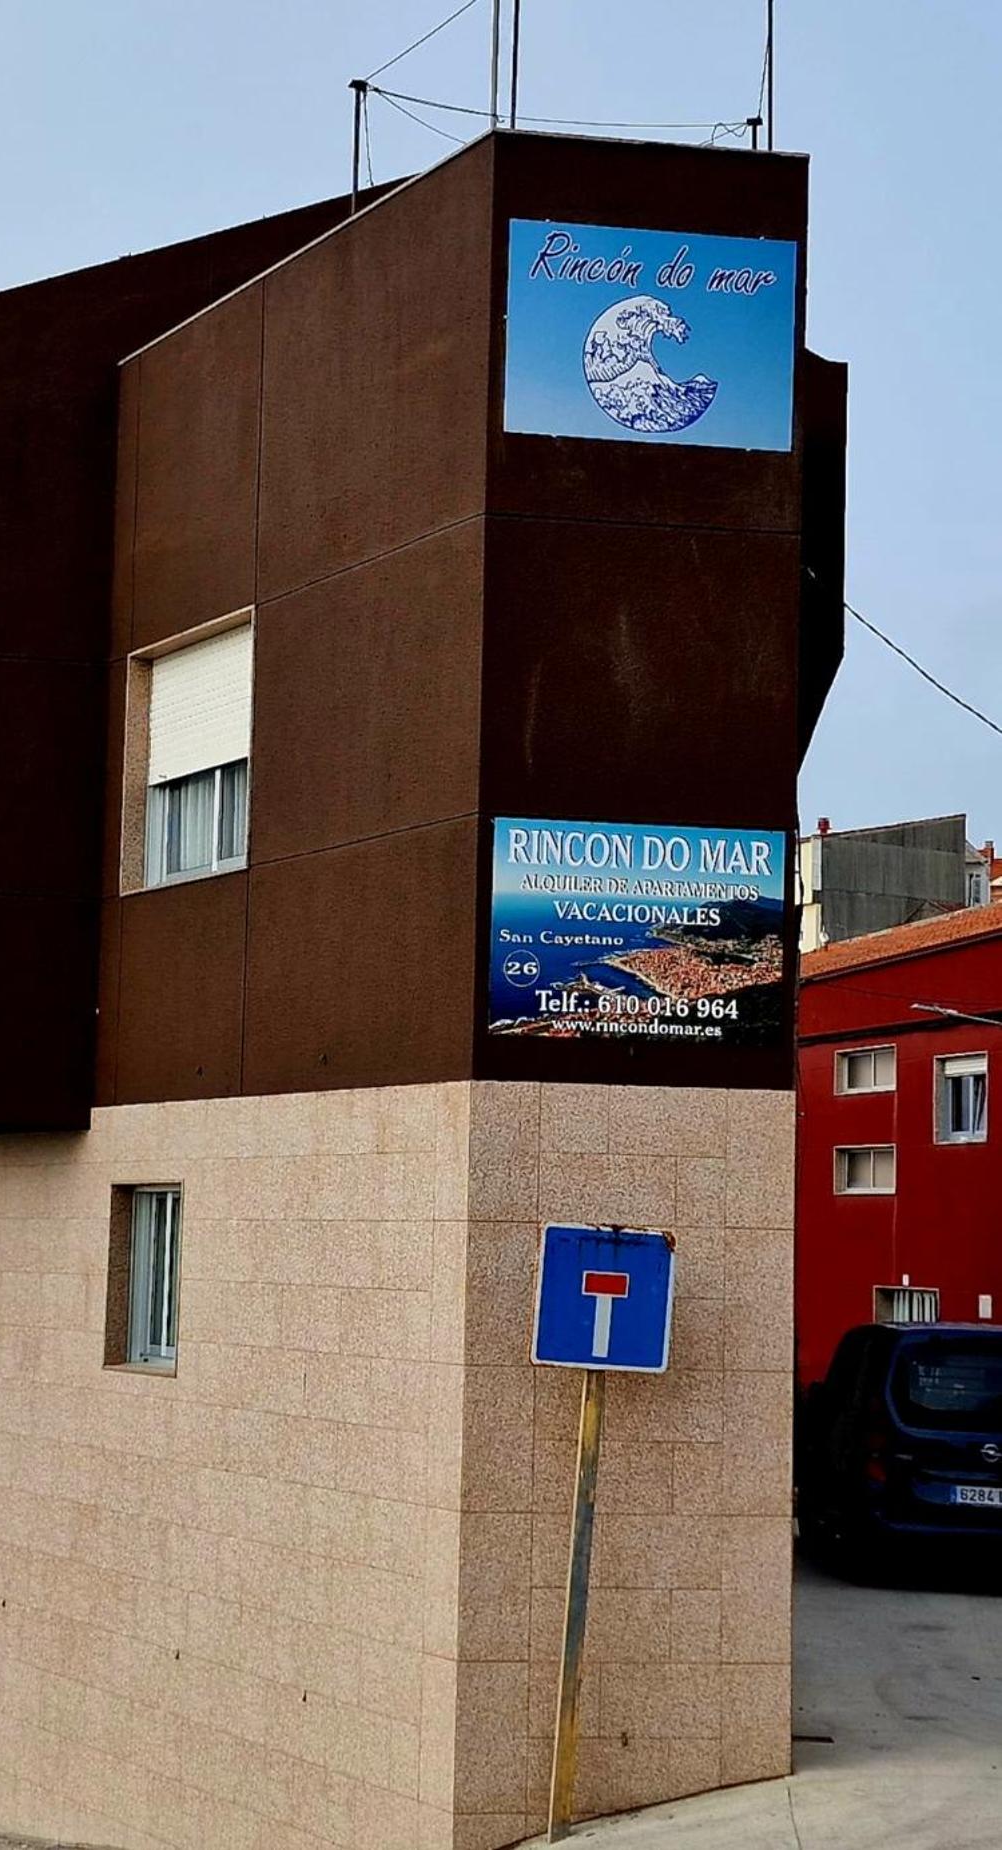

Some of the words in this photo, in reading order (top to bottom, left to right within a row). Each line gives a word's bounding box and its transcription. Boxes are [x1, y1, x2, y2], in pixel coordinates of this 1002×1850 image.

[529, 230, 644, 288] Rincón
[656, 245, 695, 289] do
[706, 265, 777, 295] mar
[507, 828, 634, 869] RINCON
[642, 835, 691, 872] DO
[698, 837, 772, 876] MAR
[520, 873, 603, 893] ALQUILER
[607, 877, 629, 894] DE
[632, 879, 759, 901] APARTAMENTOS
[553, 900, 721, 926] VACACIONALES
[499, 929, 533, 943] San
[539, 930, 624, 946] Cayetano
[506, 961, 538, 975] 26
[535, 989, 590, 1013] Telf.:
[597, 994, 639, 1015] 610
[647, 996, 689, 1017] 016
[696, 998, 739, 1020] 964
[552, 1017, 722, 1037] www.rincondomar.es
